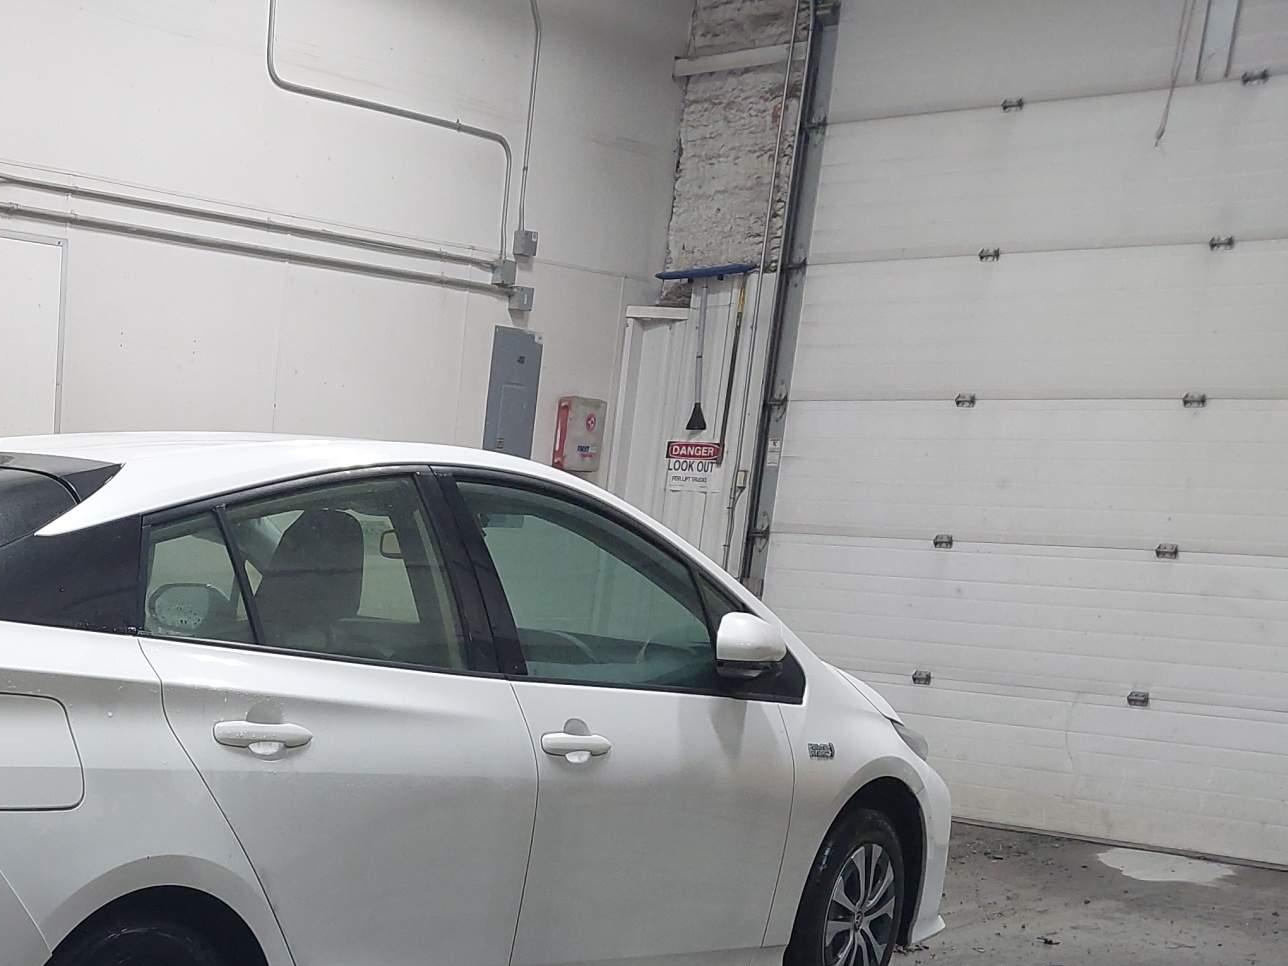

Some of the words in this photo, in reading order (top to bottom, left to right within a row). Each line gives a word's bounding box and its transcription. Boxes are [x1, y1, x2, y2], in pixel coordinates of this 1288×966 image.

[672, 445, 715, 457] DANGER
[668, 460, 694, 472] LOOK
[696, 461, 715, 473] OUT
